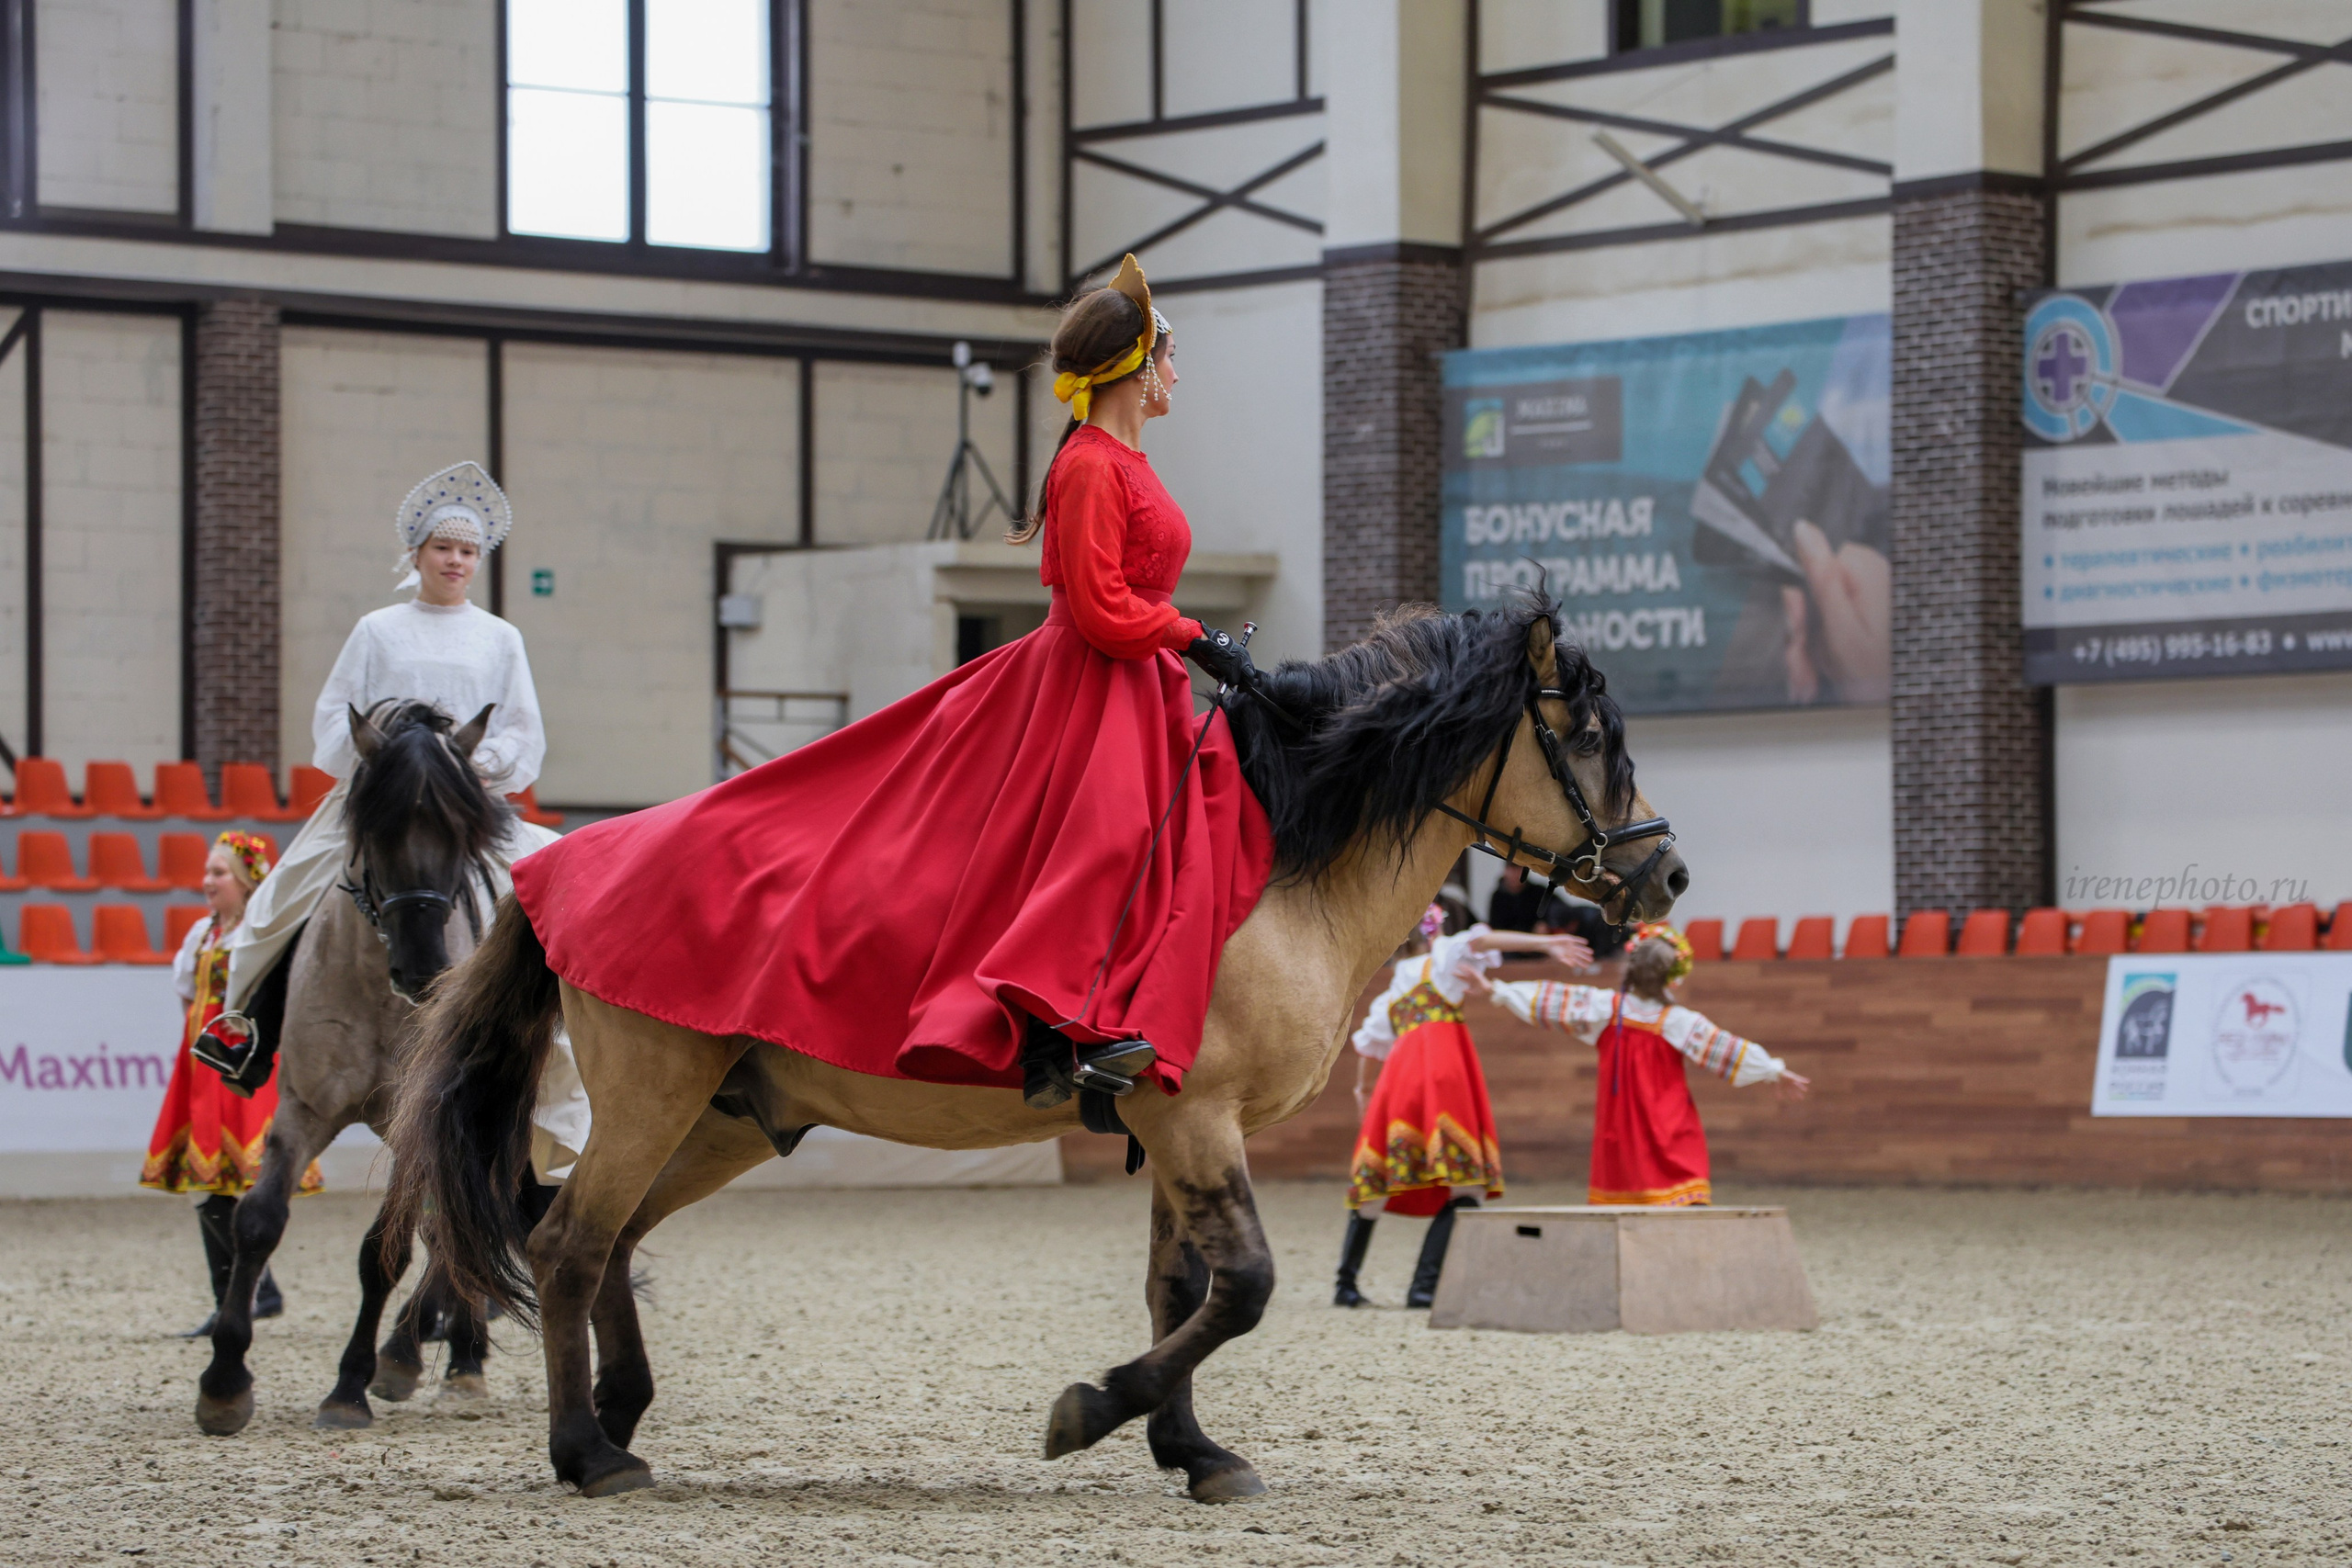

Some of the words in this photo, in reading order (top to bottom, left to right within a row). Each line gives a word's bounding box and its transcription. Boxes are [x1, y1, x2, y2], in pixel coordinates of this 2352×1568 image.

[2041, 475, 2144, 499] Новейшие
[2150, 469, 2229, 491] методы
[1464, 497, 1654, 545] БОНУСНАЯ
[2041, 506, 2155, 530] подготовки
[2162, 491, 2255, 520] лошадей
[2261, 496, 2274, 515] к
[1464, 553, 1680, 599] ПРОГРАММА
[2074, 637, 2102, 663] +7
[0, 1043, 177, 1090] Maxim
